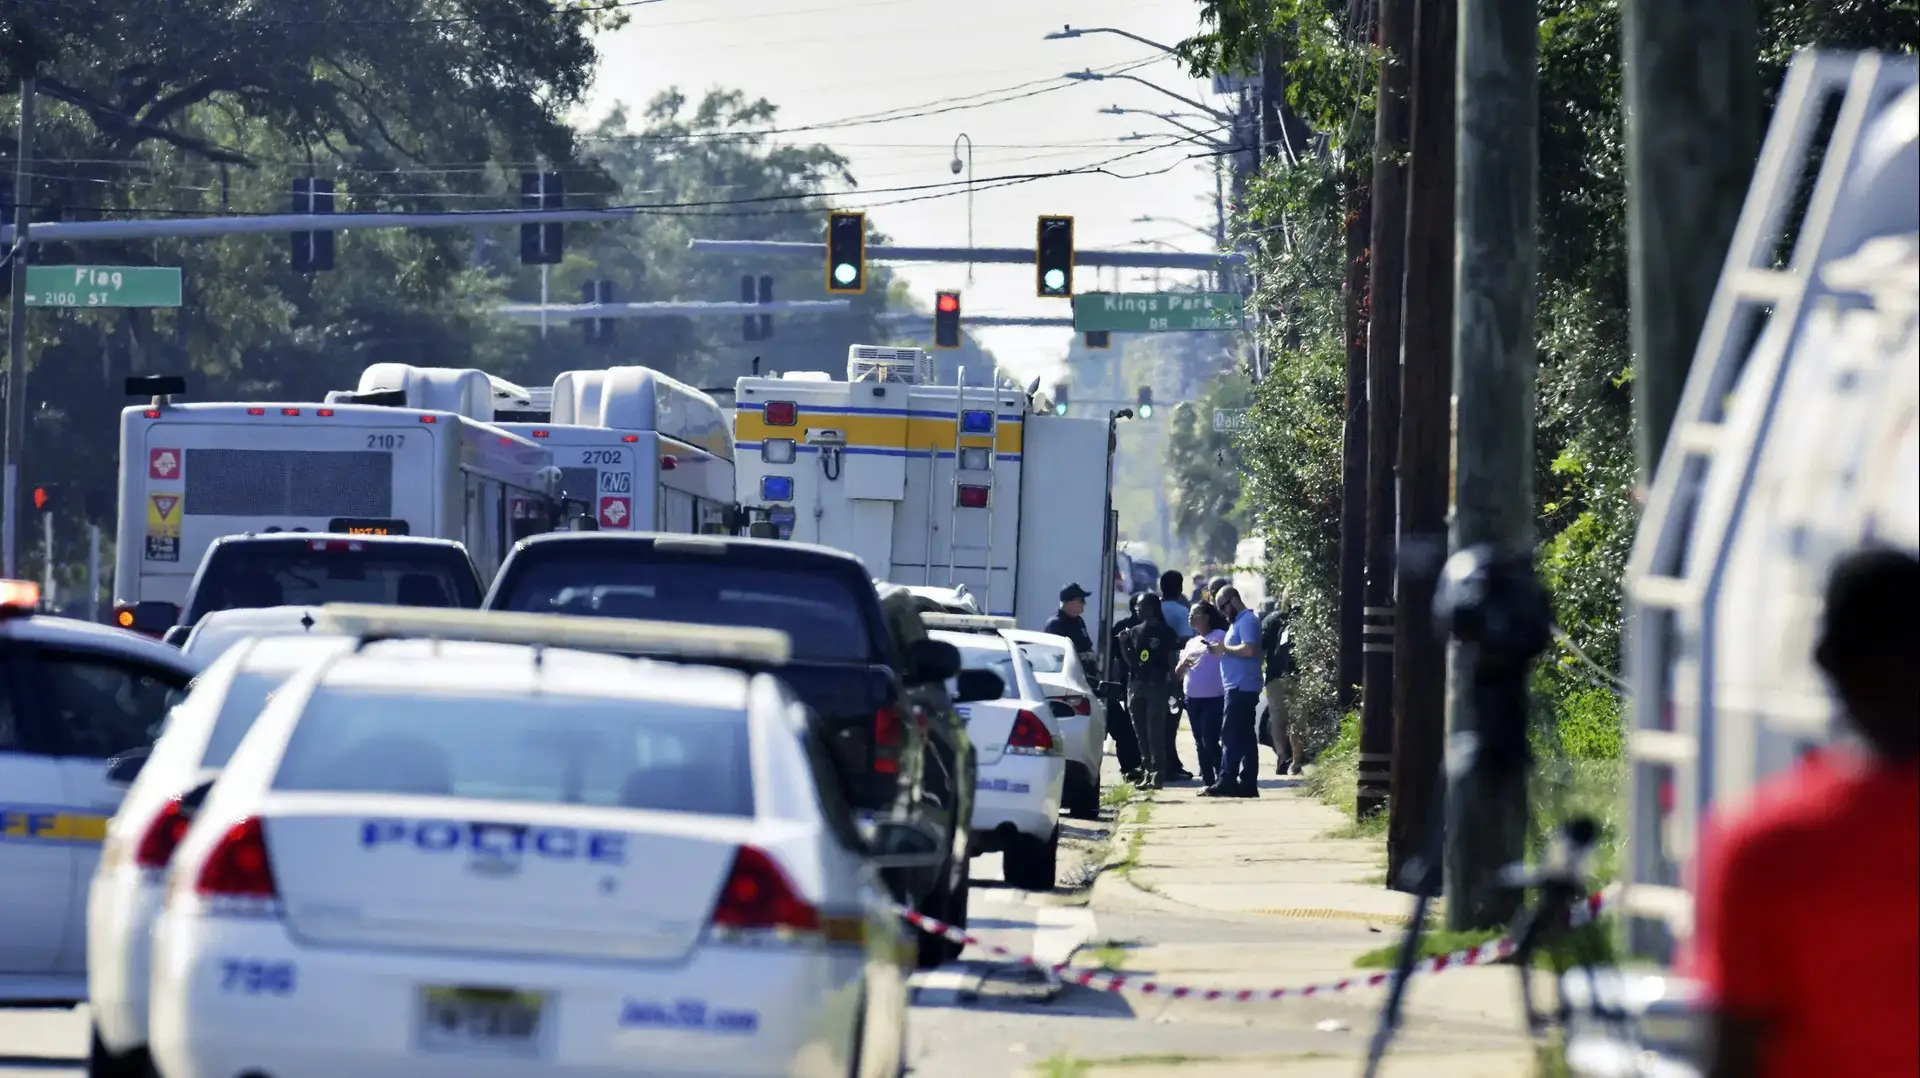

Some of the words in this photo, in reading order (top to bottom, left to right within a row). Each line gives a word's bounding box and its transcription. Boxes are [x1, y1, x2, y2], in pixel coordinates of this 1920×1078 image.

[75, 268, 122, 290] Flag
[45, 292, 76, 304] 2100
[88, 292, 109, 304] ST
[1104, 296, 1157, 313] Kings
[1168, 296, 1212, 310] Park
[1150, 317, 1168, 328] DR
[367, 434, 405, 449] 2107
[582, 450, 622, 464] 2702
[601, 473, 630, 492] CNG
[359, 816, 629, 866] POLICE
